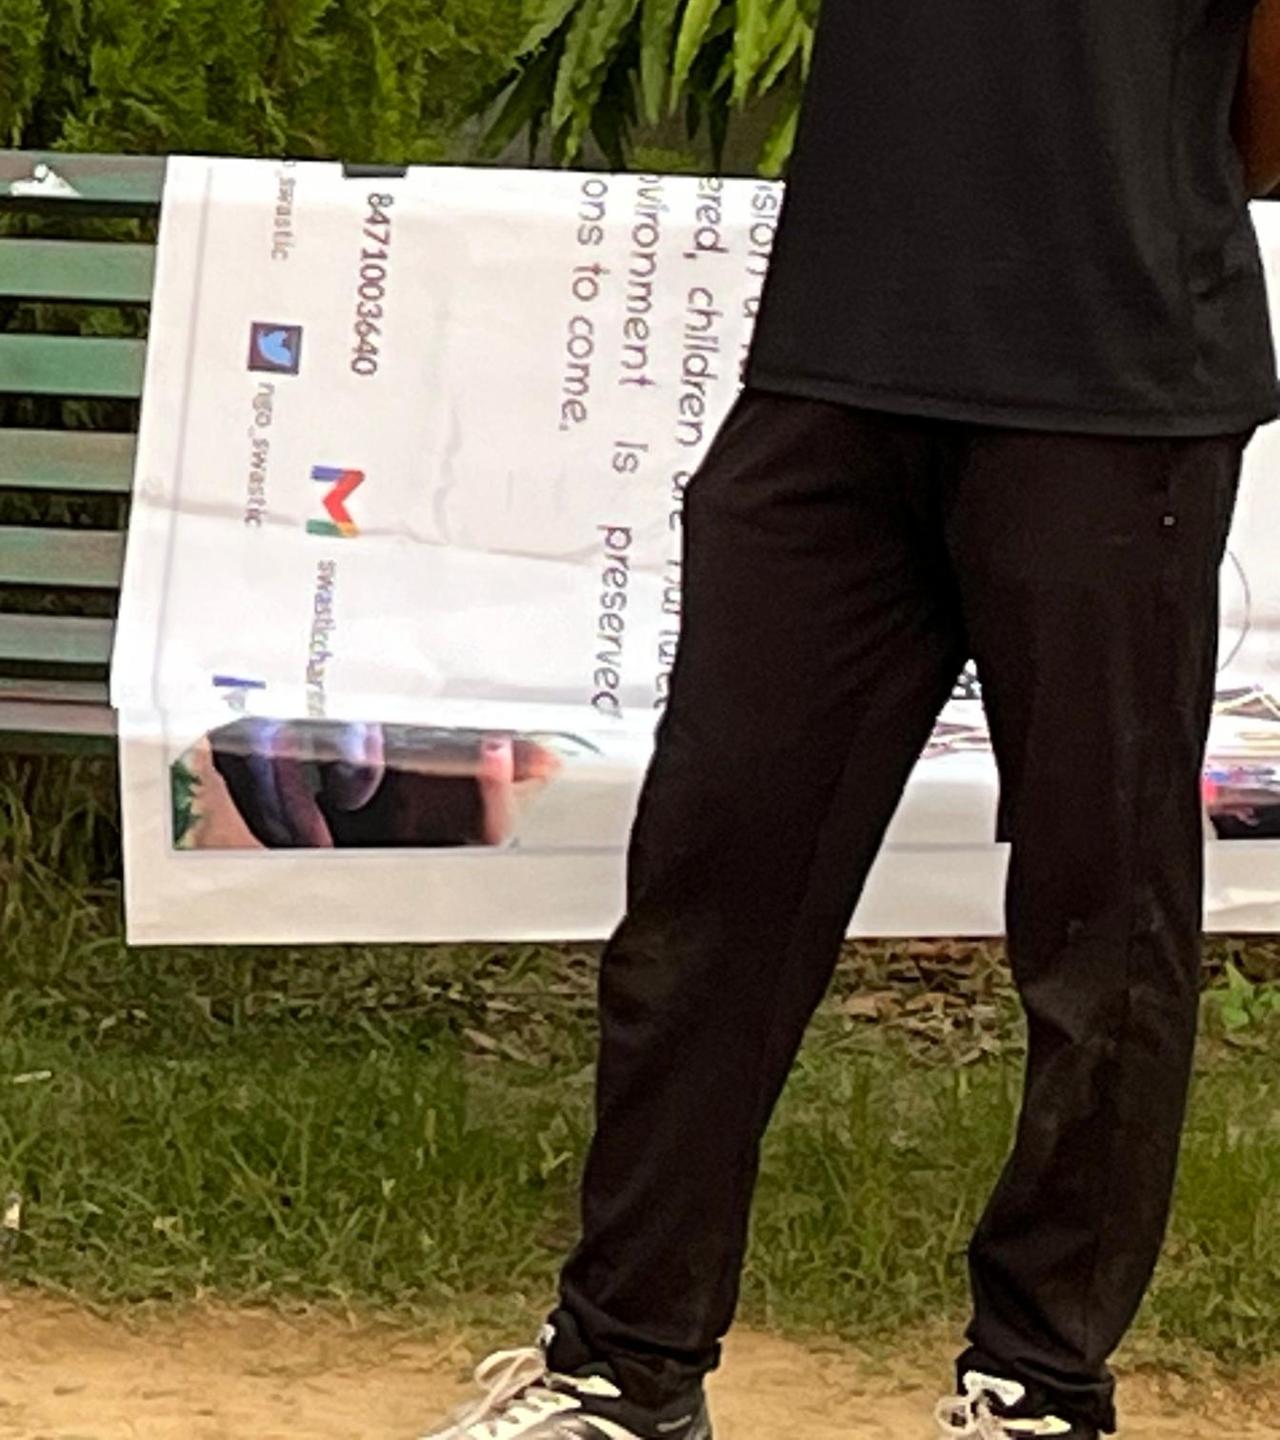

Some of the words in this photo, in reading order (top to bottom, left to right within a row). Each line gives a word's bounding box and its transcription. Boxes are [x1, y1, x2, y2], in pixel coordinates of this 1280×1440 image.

[351, 192, 394, 376] 8471003640
[572, 264, 610, 301] to
[559, 316, 595, 431] come.
[676, 287, 723, 446] children
